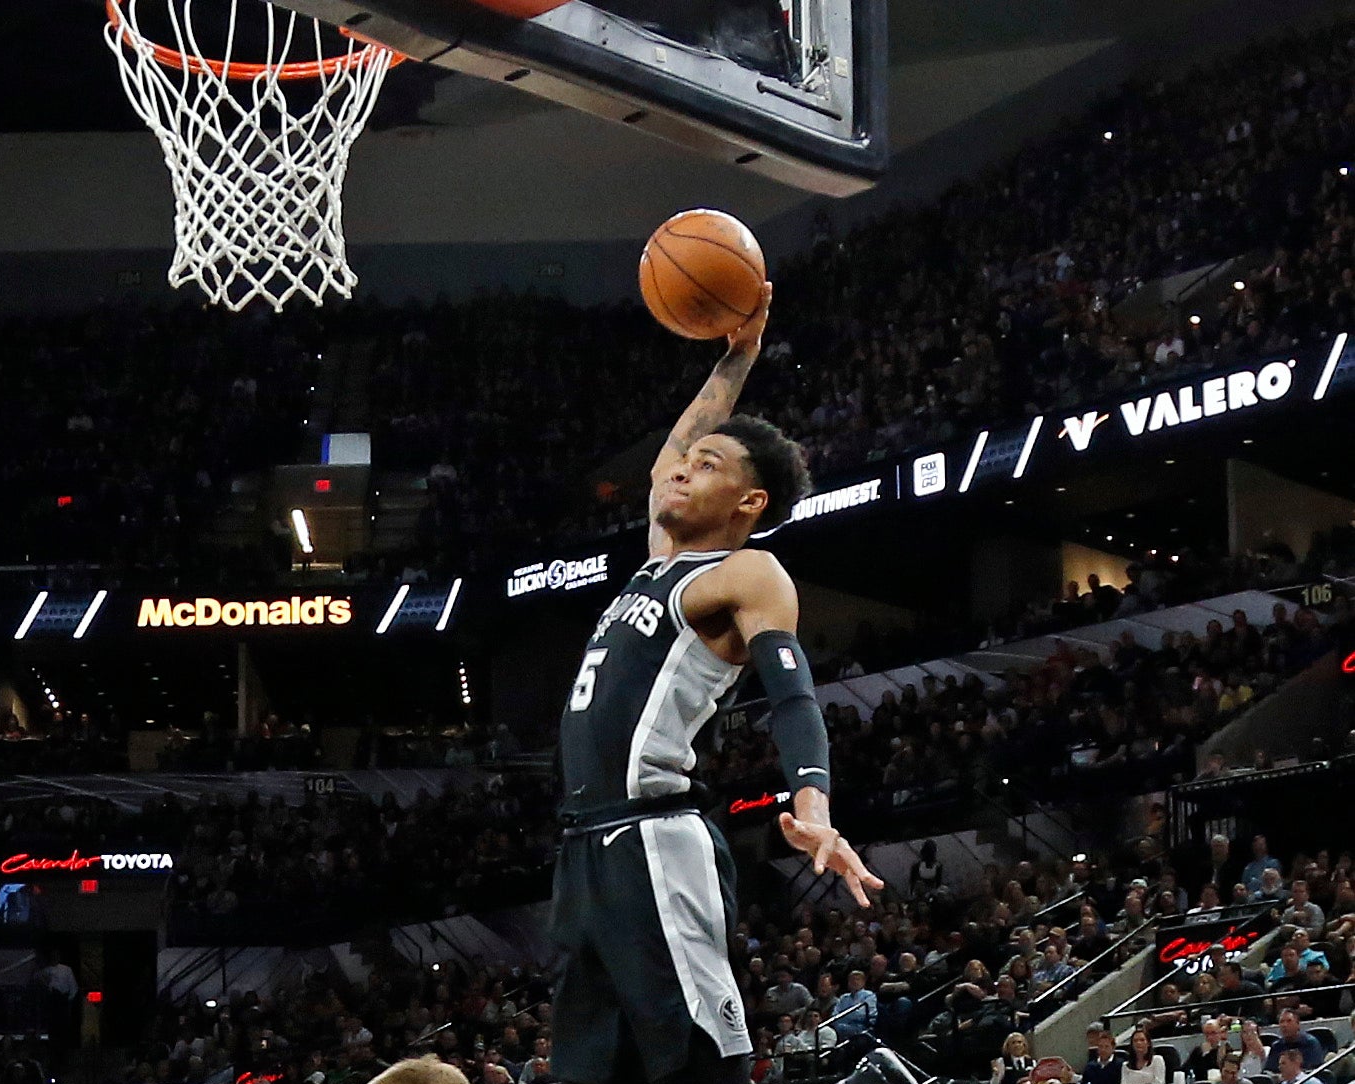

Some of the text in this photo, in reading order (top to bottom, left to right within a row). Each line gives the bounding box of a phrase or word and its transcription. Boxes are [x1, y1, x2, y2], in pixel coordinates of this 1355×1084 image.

[1120, 361, 1292, 436] VALERO
[792, 479, 881, 521] OUTHWEST
[507, 571, 548, 597] LUCKY
[566, 554, 609, 581] EAGLE
[1301, 583, 1333, 606] 106
[137, 596, 352, 627] McDonald's
[570, 647, 608, 712] 5
[101, 853, 173, 869] TOYOTA
